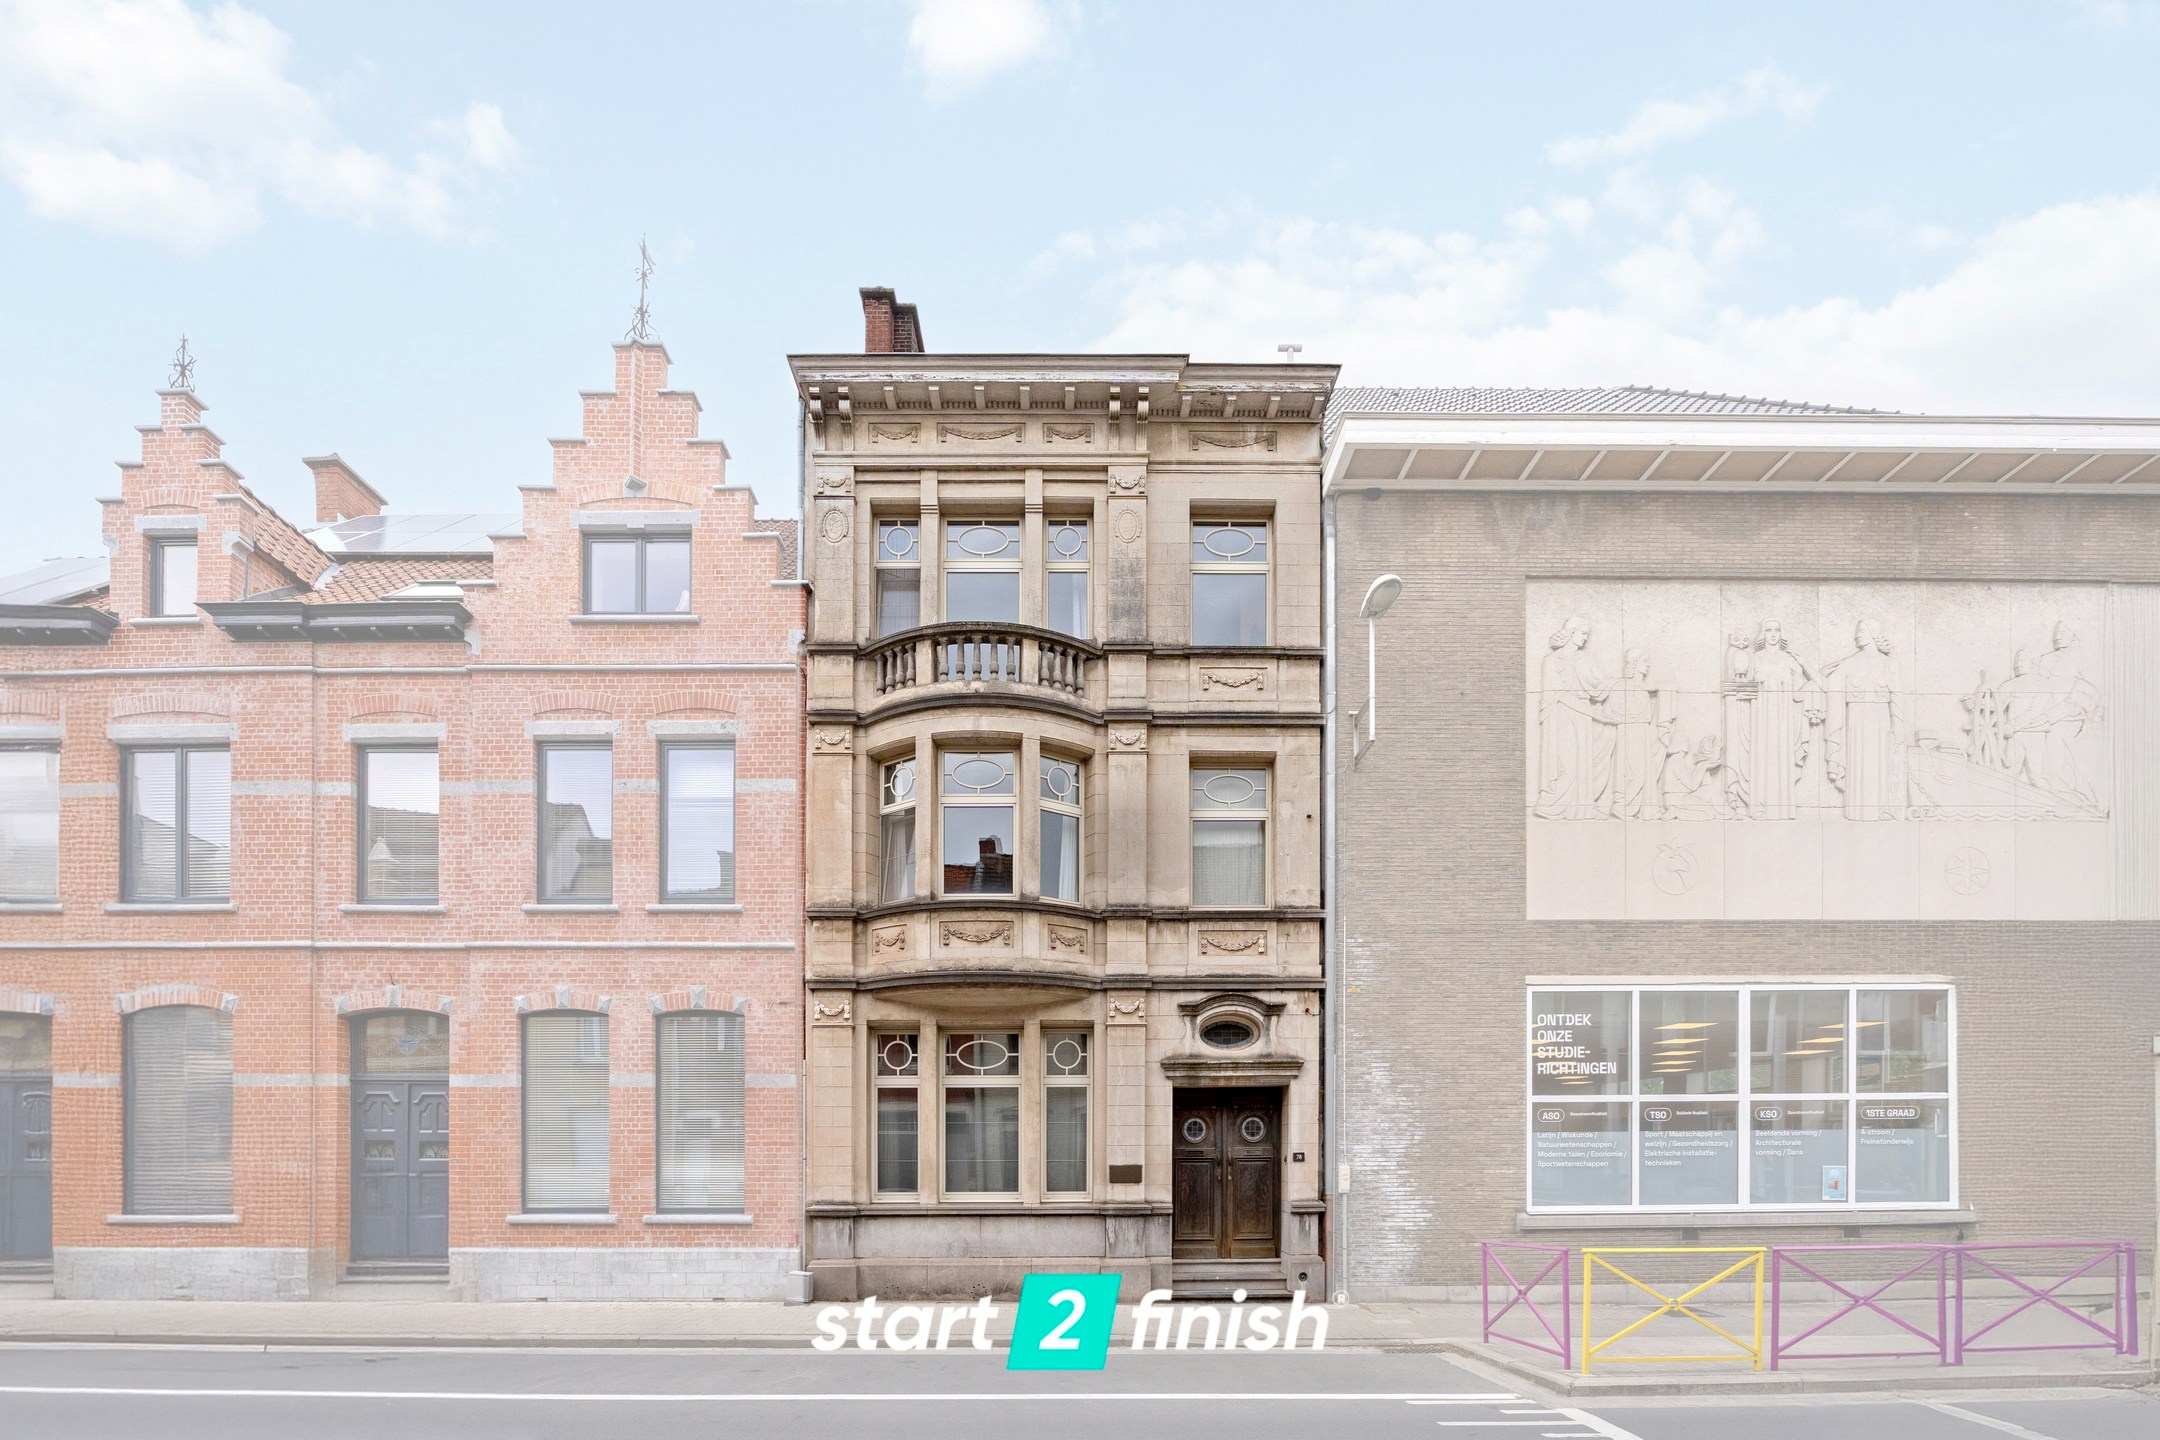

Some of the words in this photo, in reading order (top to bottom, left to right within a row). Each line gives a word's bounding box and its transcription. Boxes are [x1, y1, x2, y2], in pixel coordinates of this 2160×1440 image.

[1537, 1014, 1592, 1026] ONTDEK
[1537, 1030, 1573, 1042] ONZE
[1537, 1046, 1591, 1058] STUDIE-
[1537, 1062, 1617, 1075] RICHTINGEN
[1542, 1112, 1560, 1120] ASO
[1650, 1111, 1667, 1119] TSO
[1760, 1110, 1777, 1118] KSO
[1866, 1109, 1885, 1117] 1STE
[1886, 1109, 1915, 1117] GRAAD
[1537, 1141, 1613, 1149] Natuurwetenschappen
[1672, 1140, 1729, 1148] Gezondheidszorg
[1537, 1160, 1609, 1168] Sportwetenschappen
